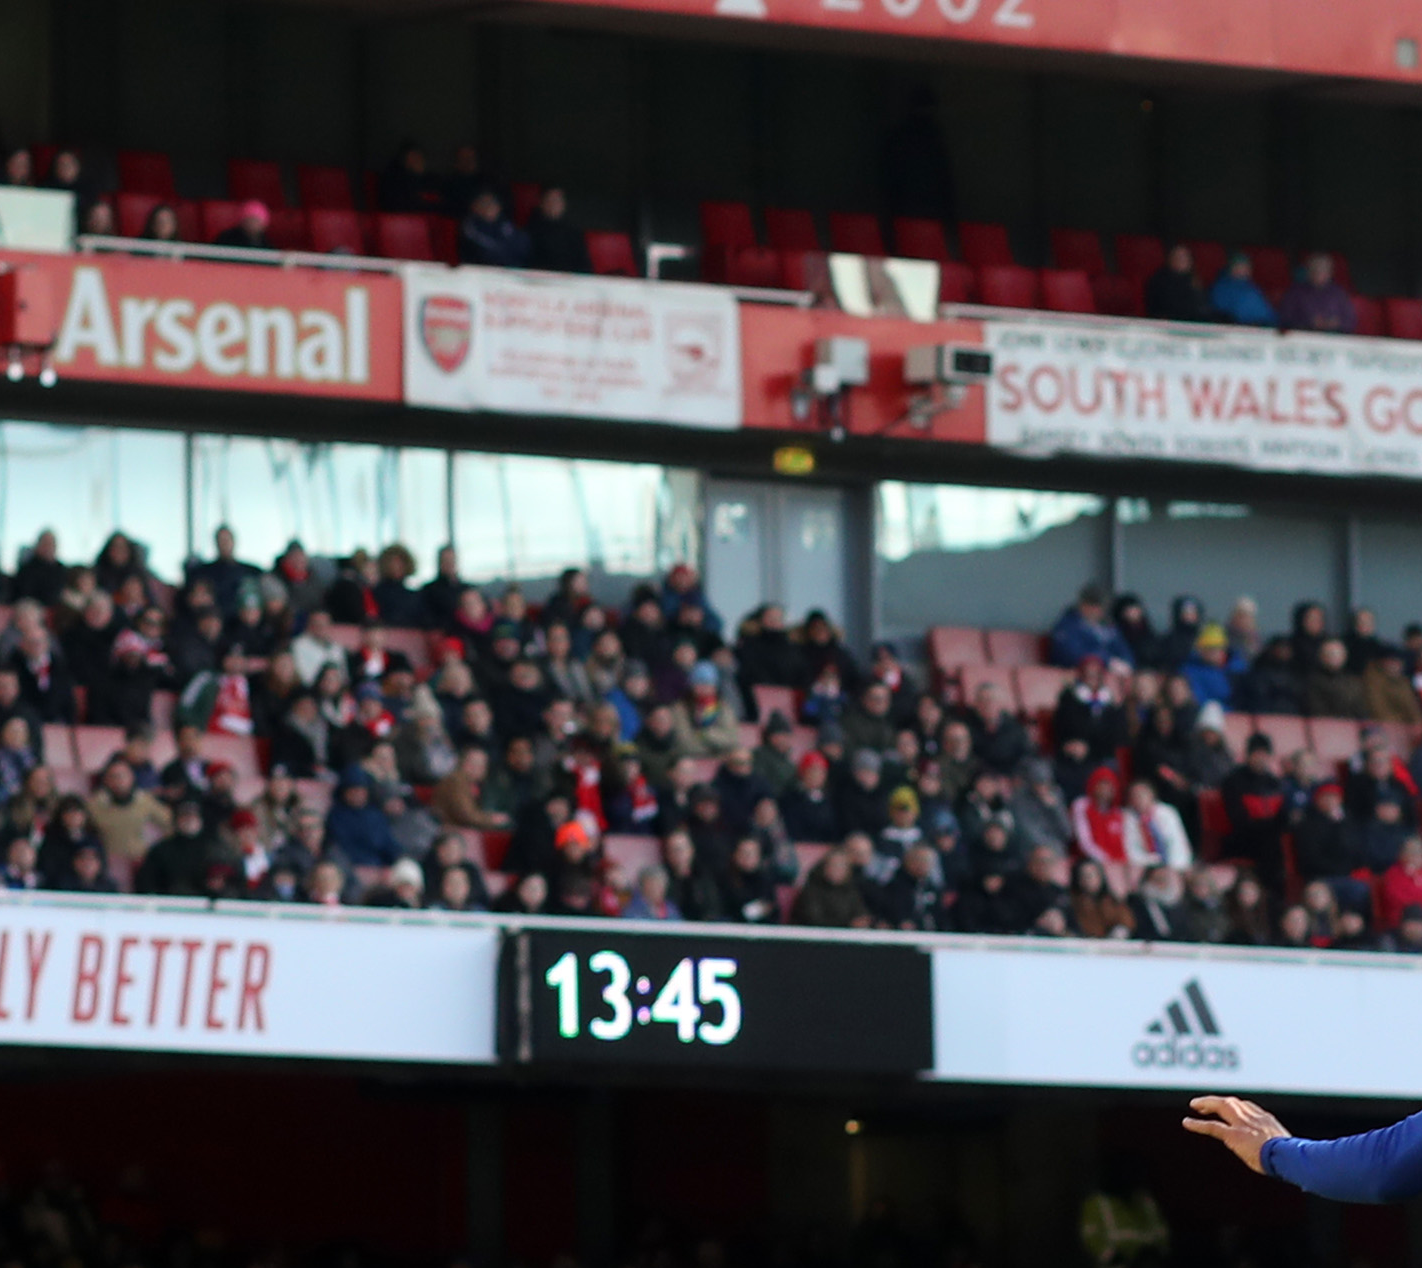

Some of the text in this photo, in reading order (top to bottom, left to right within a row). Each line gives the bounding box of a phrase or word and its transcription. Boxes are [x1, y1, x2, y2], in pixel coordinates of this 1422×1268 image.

[55, 266, 370, 384] Arsenal
[997, 362, 1169, 420] SOUTH
[1182, 375, 1348, 429] WALES
[72, 934, 274, 1034] BETTER
[545, 950, 742, 1045] 13:45
[1130, 1037, 1242, 1073] adidas
